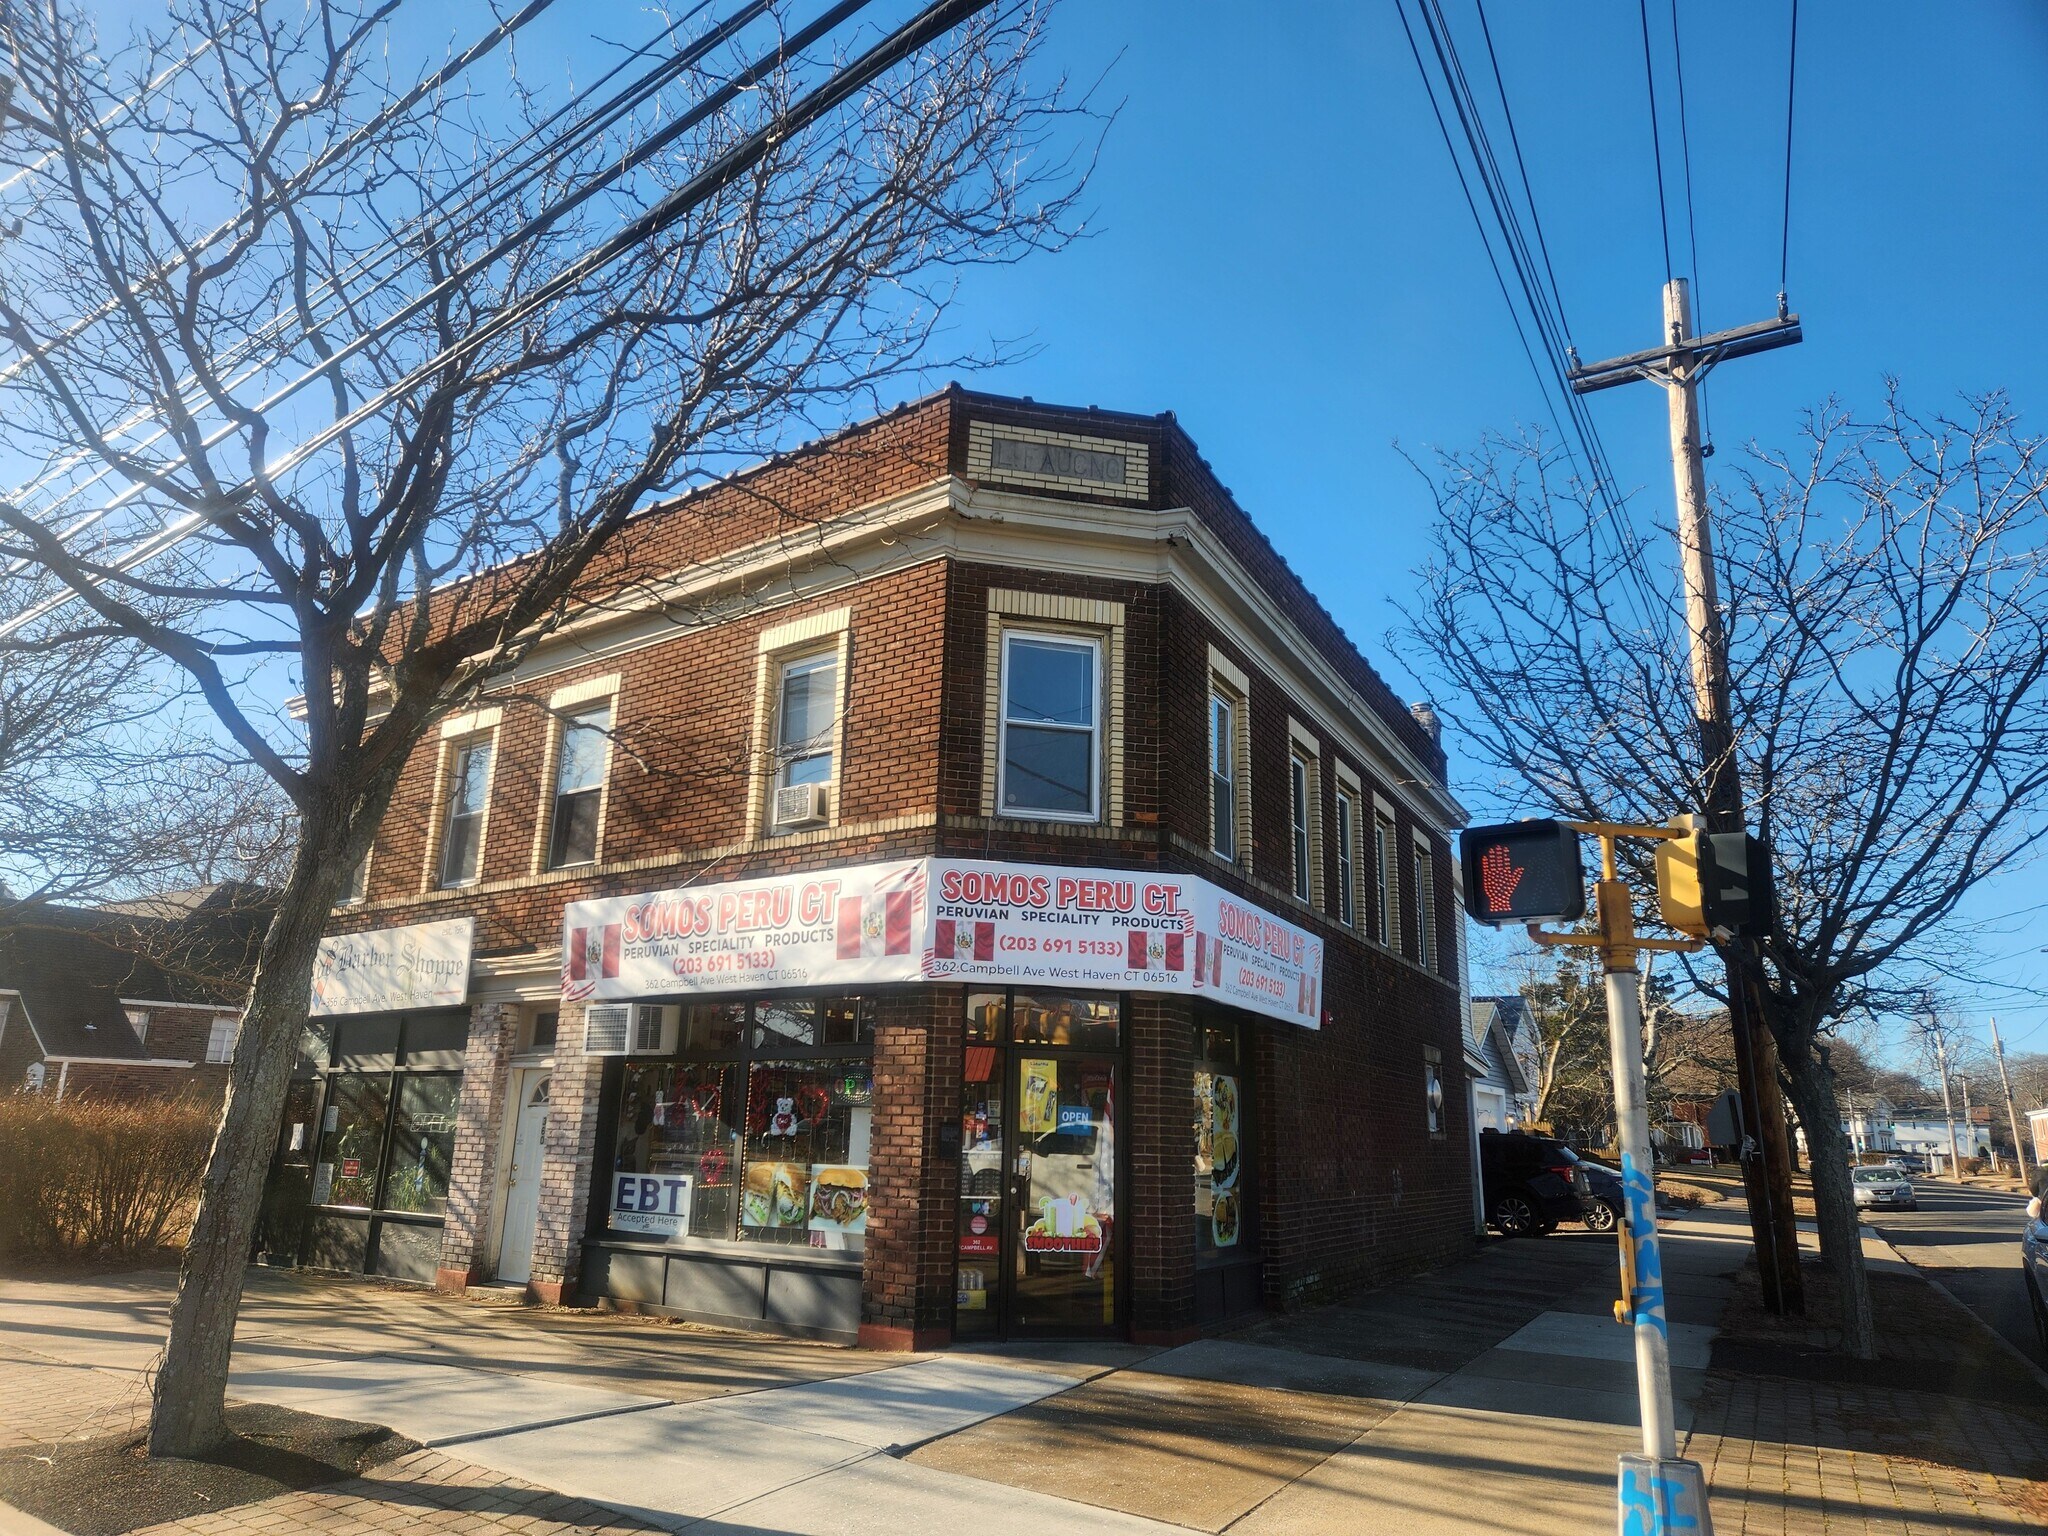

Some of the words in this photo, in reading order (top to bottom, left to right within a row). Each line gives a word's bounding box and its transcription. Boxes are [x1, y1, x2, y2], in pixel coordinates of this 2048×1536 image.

[940, 869, 1050, 907] SOMOS
[1056, 877, 1135, 913] PERU
[1142, 882, 1182, 916] CT
[622, 894, 713, 944] SOMOS
[717, 885, 795, 934] PERU
[798, 878, 841, 927] CT
[936, 905, 1009, 920] PERUVIAN
[1021, 911, 1100, 925] SPECIALITY
[1112, 917, 1184, 930] PRODUCTS
[624, 943, 679, 960] PERUVIAN
[688, 937, 754, 955] SPECIALITY
[765, 928, 834, 947] PRODUCTS
[999, 934, 1037, 951] (203
[1042, 938, 1073, 954] 691
[1078, 940, 1123, 957] 5133)
[1218, 897, 1262, 951] SOMOS
[1263, 918, 1291, 964] PERU
[1293, 933, 1305, 969] CT
[336, 943, 393, 980] Barber
[396, 943, 463, 984] Shoppe
[672, 957, 702, 976] (203
[707, 954, 732, 972] 691
[737, 949, 775, 970] 5133)
[960, 962, 1020, 977] Campbell
[1023, 967, 1046, 977] Ave
[1049, 967, 1079, 979] West
[1082, 969, 1120, 981] Haven
[1124, 971, 1140, 982] CT
[1143, 972, 1178, 983] 06516
[1223, 944, 1248, 962] PERUVIAN
[1252, 955, 1277, 973] SPECIALITY
[1279, 966, 1300, 982] PRODUCTS
[645, 979, 660, 990] 362
[660, 976, 698, 989] Campbell
[701, 974, 715, 986] Ave
[716, 973, 738, 984] West
[739, 971, 765, 982] Haven
[767, 970, 780, 981] CT
[781, 968, 808, 980] 06516
[1239, 967, 1254, 988] (203
[1256, 974, 1268, 993] 691
[1269, 978, 1286, 999] 5133)
[340, 994, 371, 1008] Campbell
[390, 992, 408, 1002] West
[409, 990, 433, 1000] Haven
[1061, 1111, 1089, 1122] OPEN
[617, 1177, 686, 1213] EBT
[618, 1213, 655, 1224] Accepted
[657, 1216, 678, 1226] Here
[1026, 1236, 1100, 1250] SMOOTHIES
